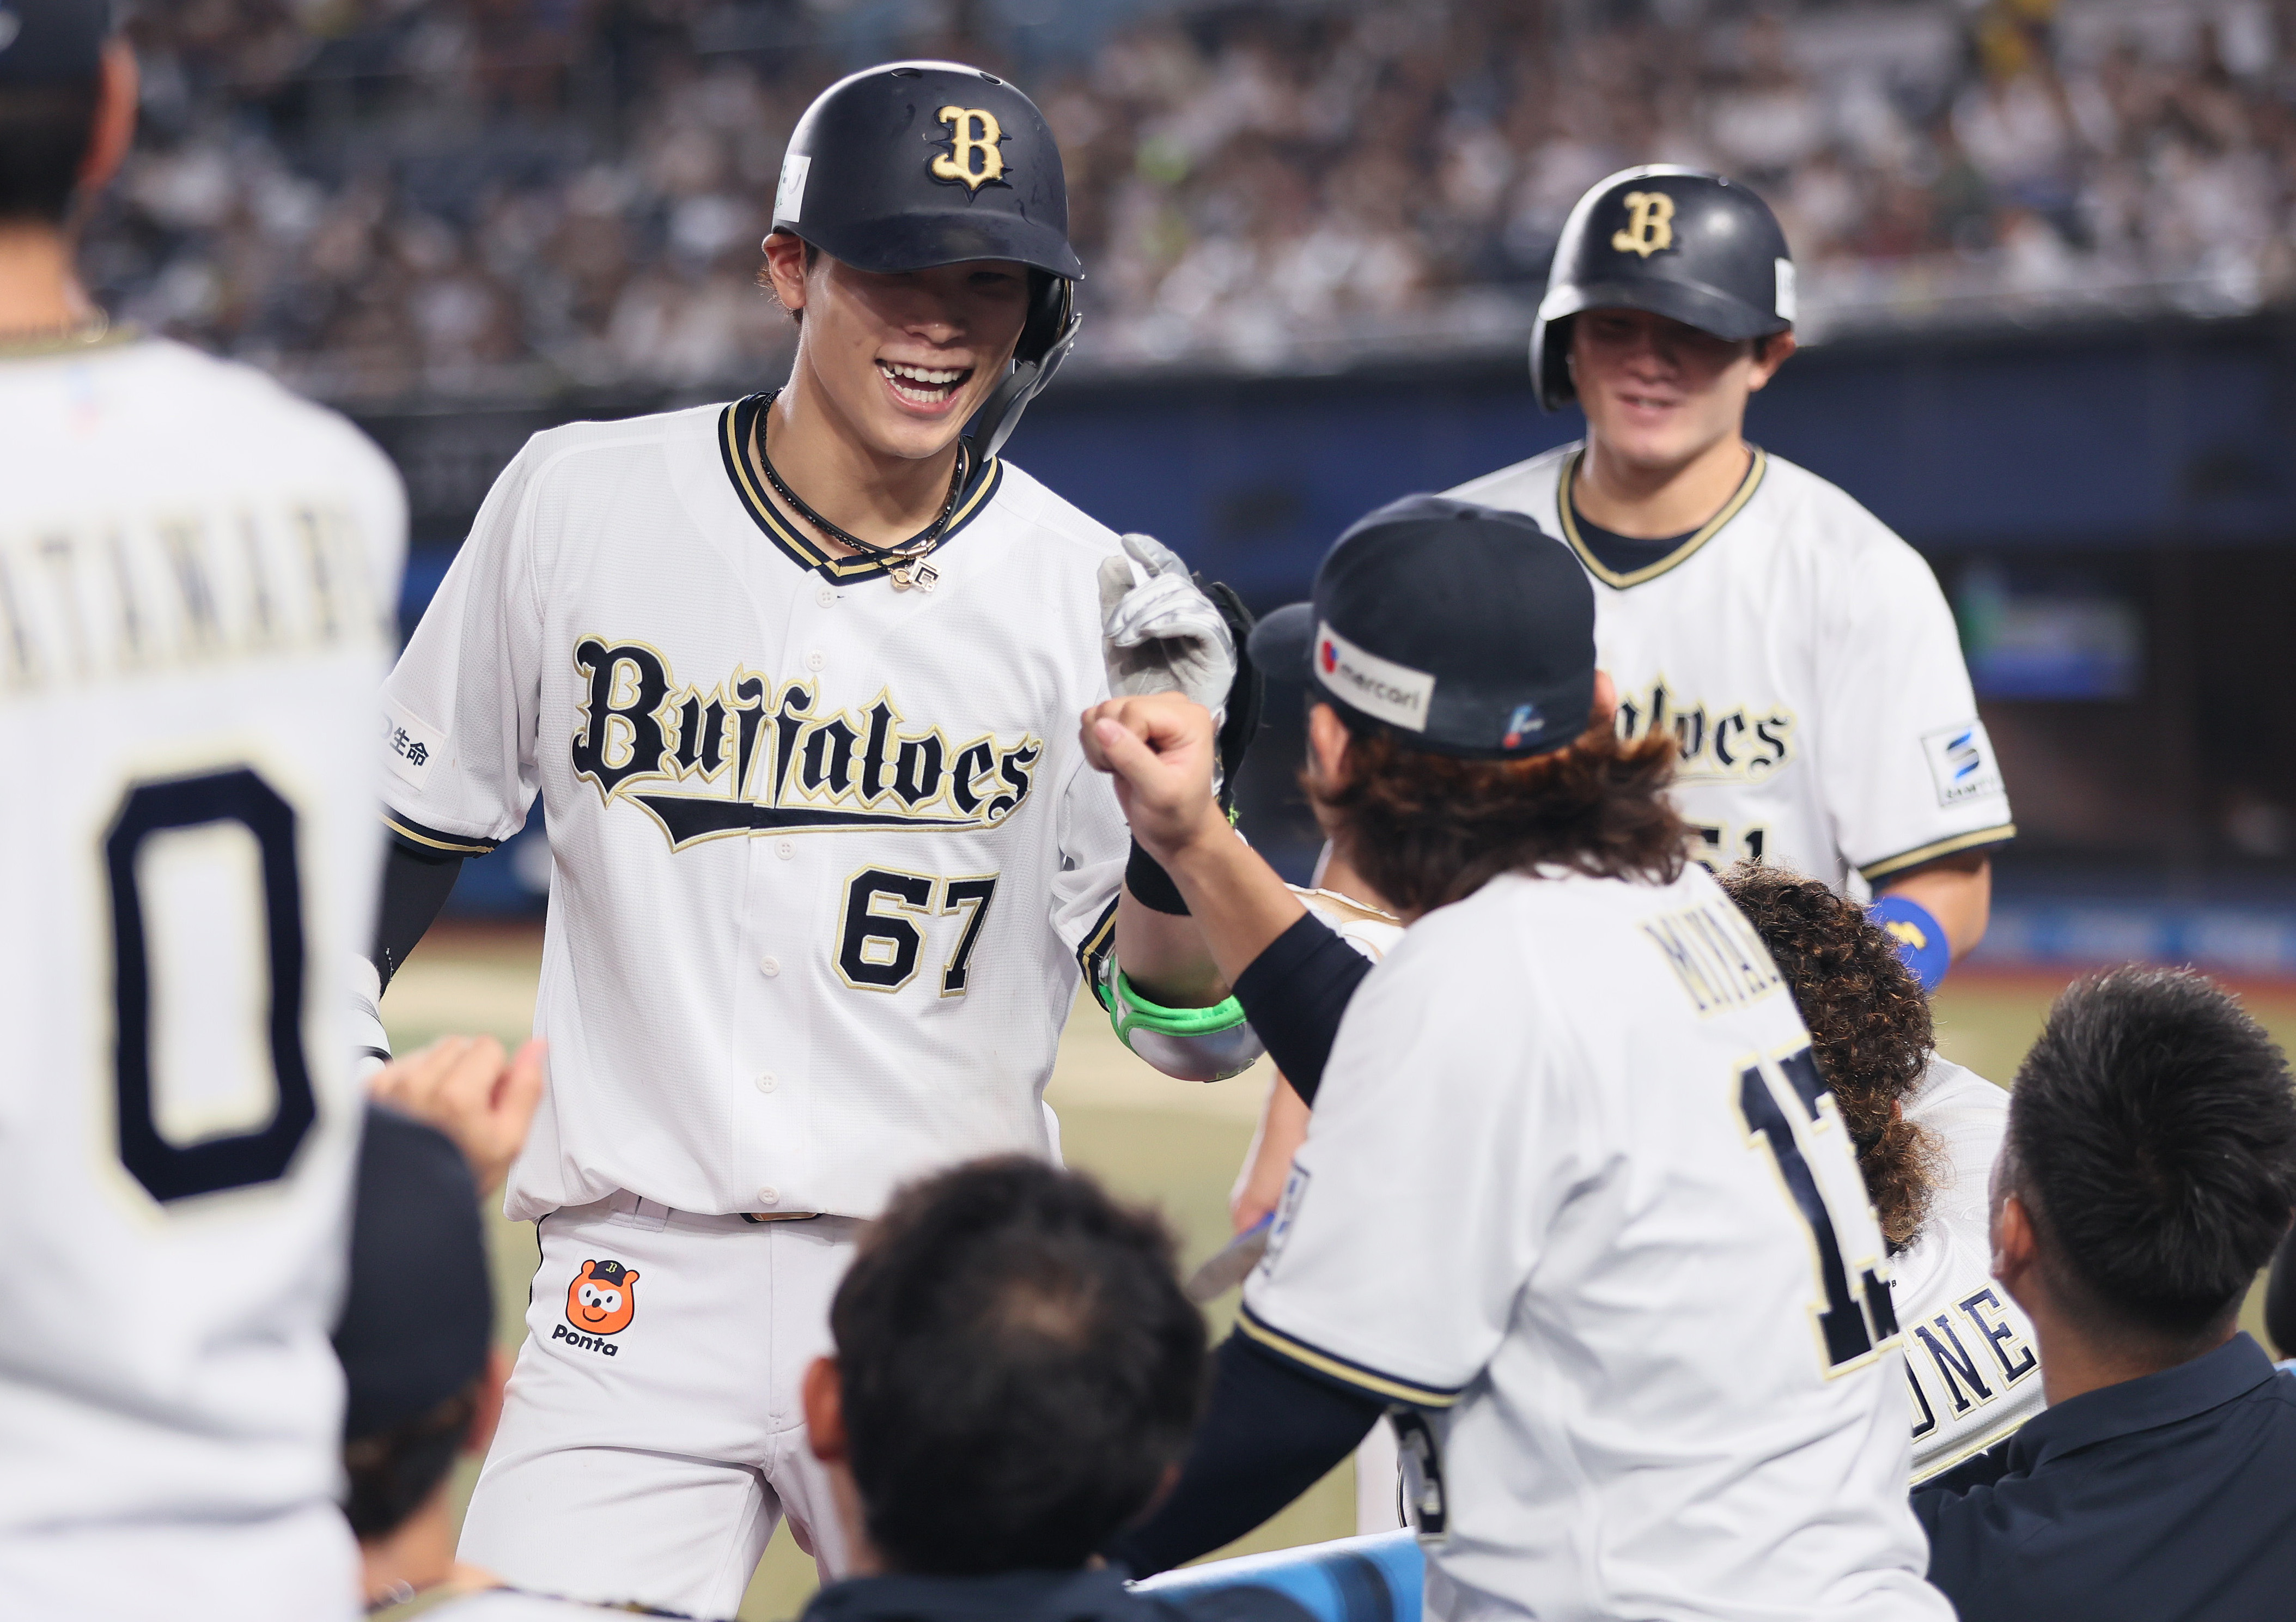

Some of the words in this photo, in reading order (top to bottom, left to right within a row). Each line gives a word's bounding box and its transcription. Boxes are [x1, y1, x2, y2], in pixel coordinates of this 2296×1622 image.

[927, 105, 1012, 199] B
[1611, 191, 1676, 258] B
[1339, 663, 1421, 710] mercari
[389, 726, 430, 766] 生命
[571, 632, 1044, 835] Buffaloes
[832, 863, 1000, 998] 67
[98, 756, 322, 1211] 0
[551, 1324, 619, 1357] Ponta
